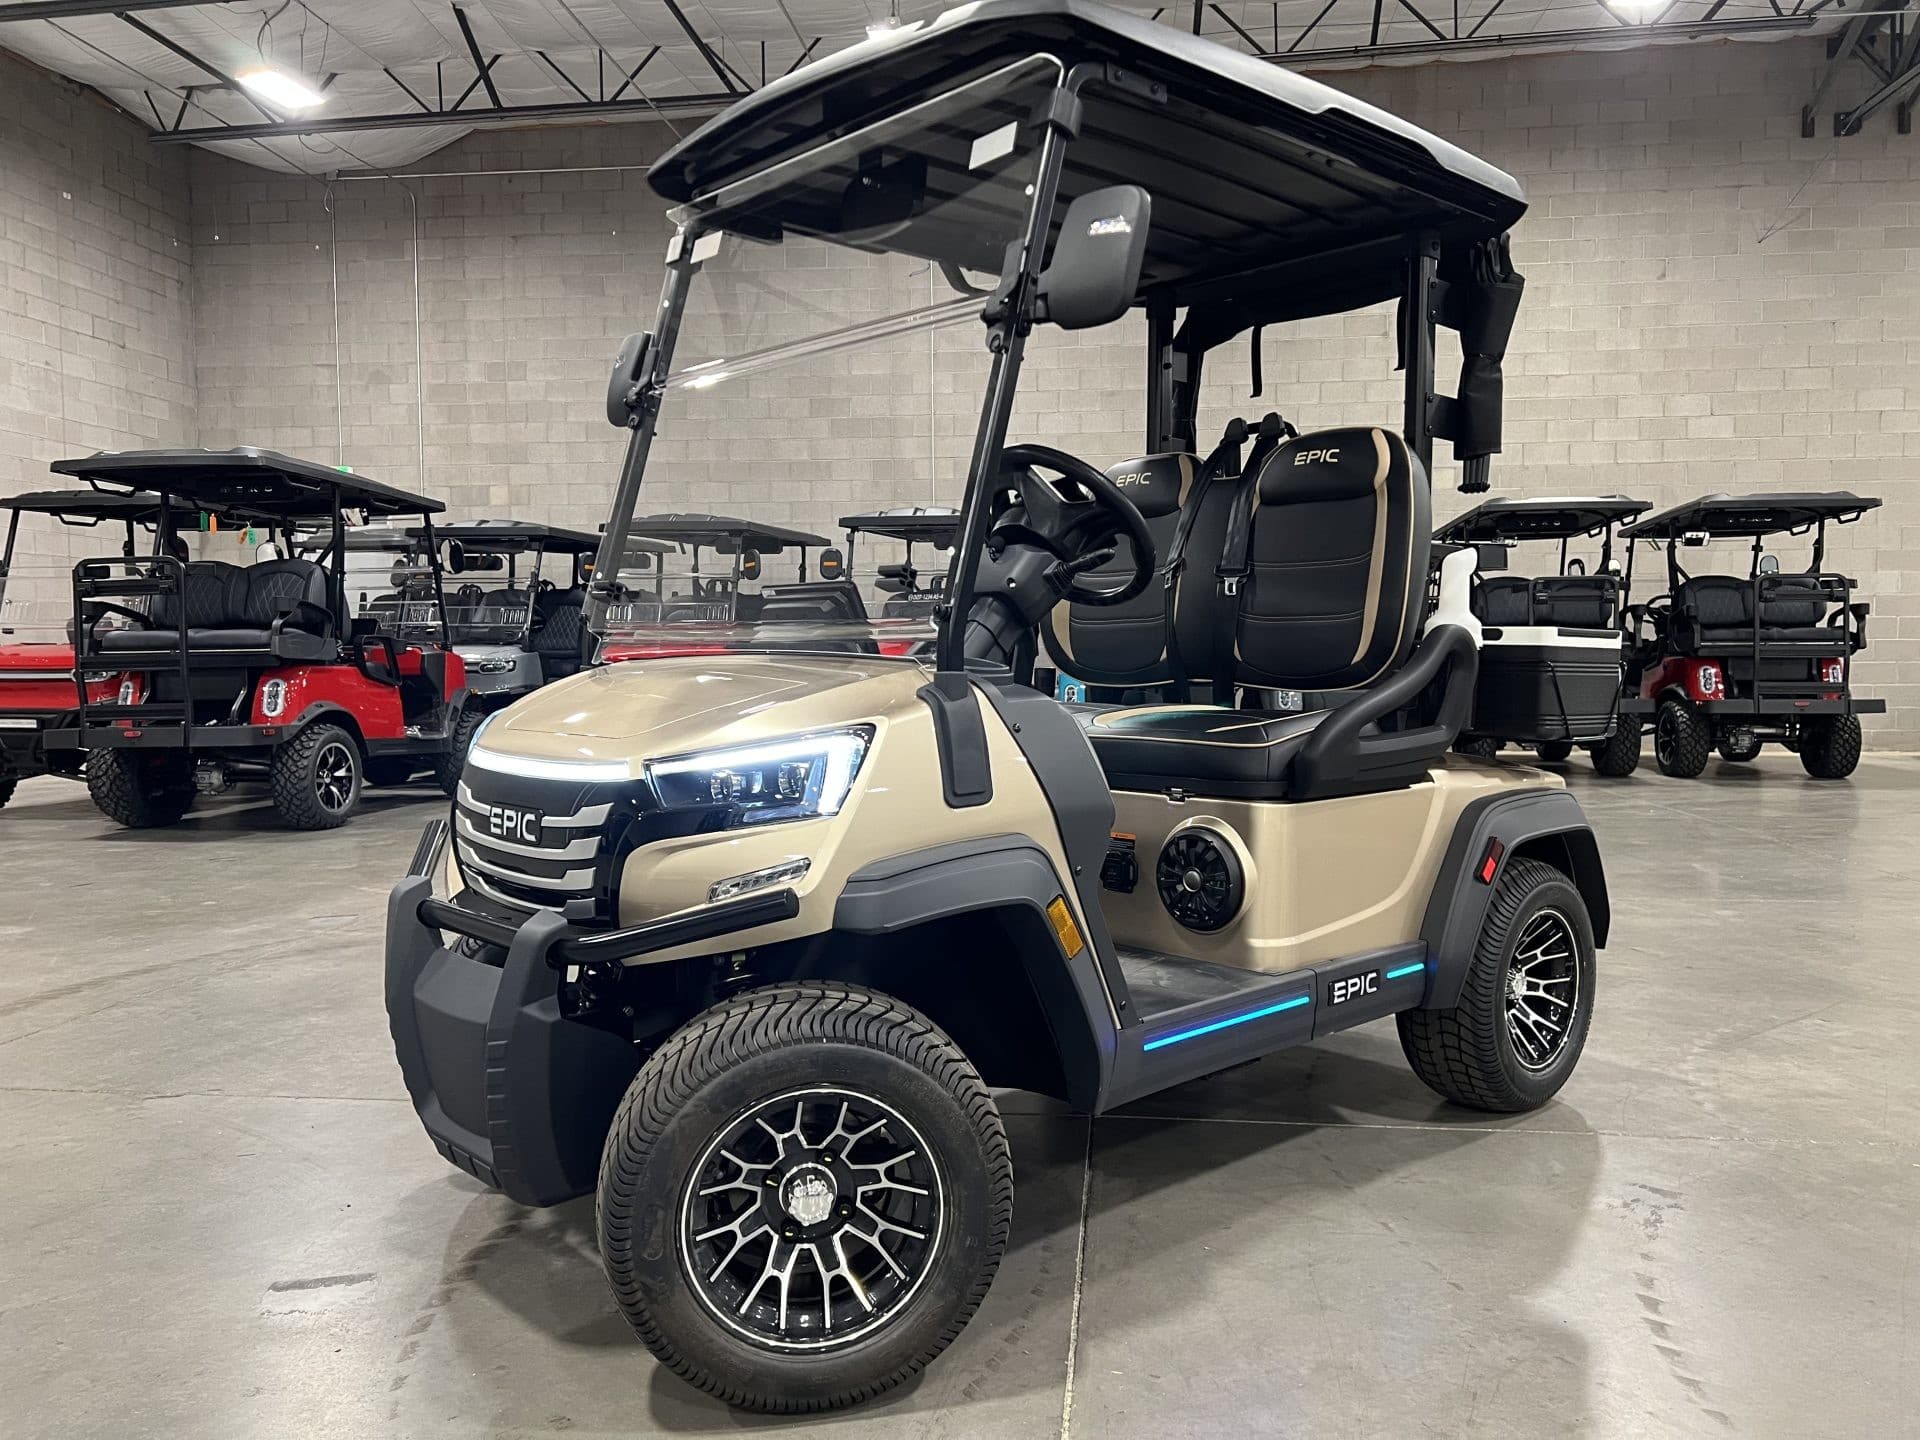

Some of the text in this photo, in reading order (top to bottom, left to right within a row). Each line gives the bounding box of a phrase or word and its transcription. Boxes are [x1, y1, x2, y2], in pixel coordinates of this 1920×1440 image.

[1294, 449, 1340, 466] EPIC
[1116, 472, 1152, 487] EPIC
[490, 806, 536, 842] EPIC
[1333, 972, 1377, 1004] EPIC
